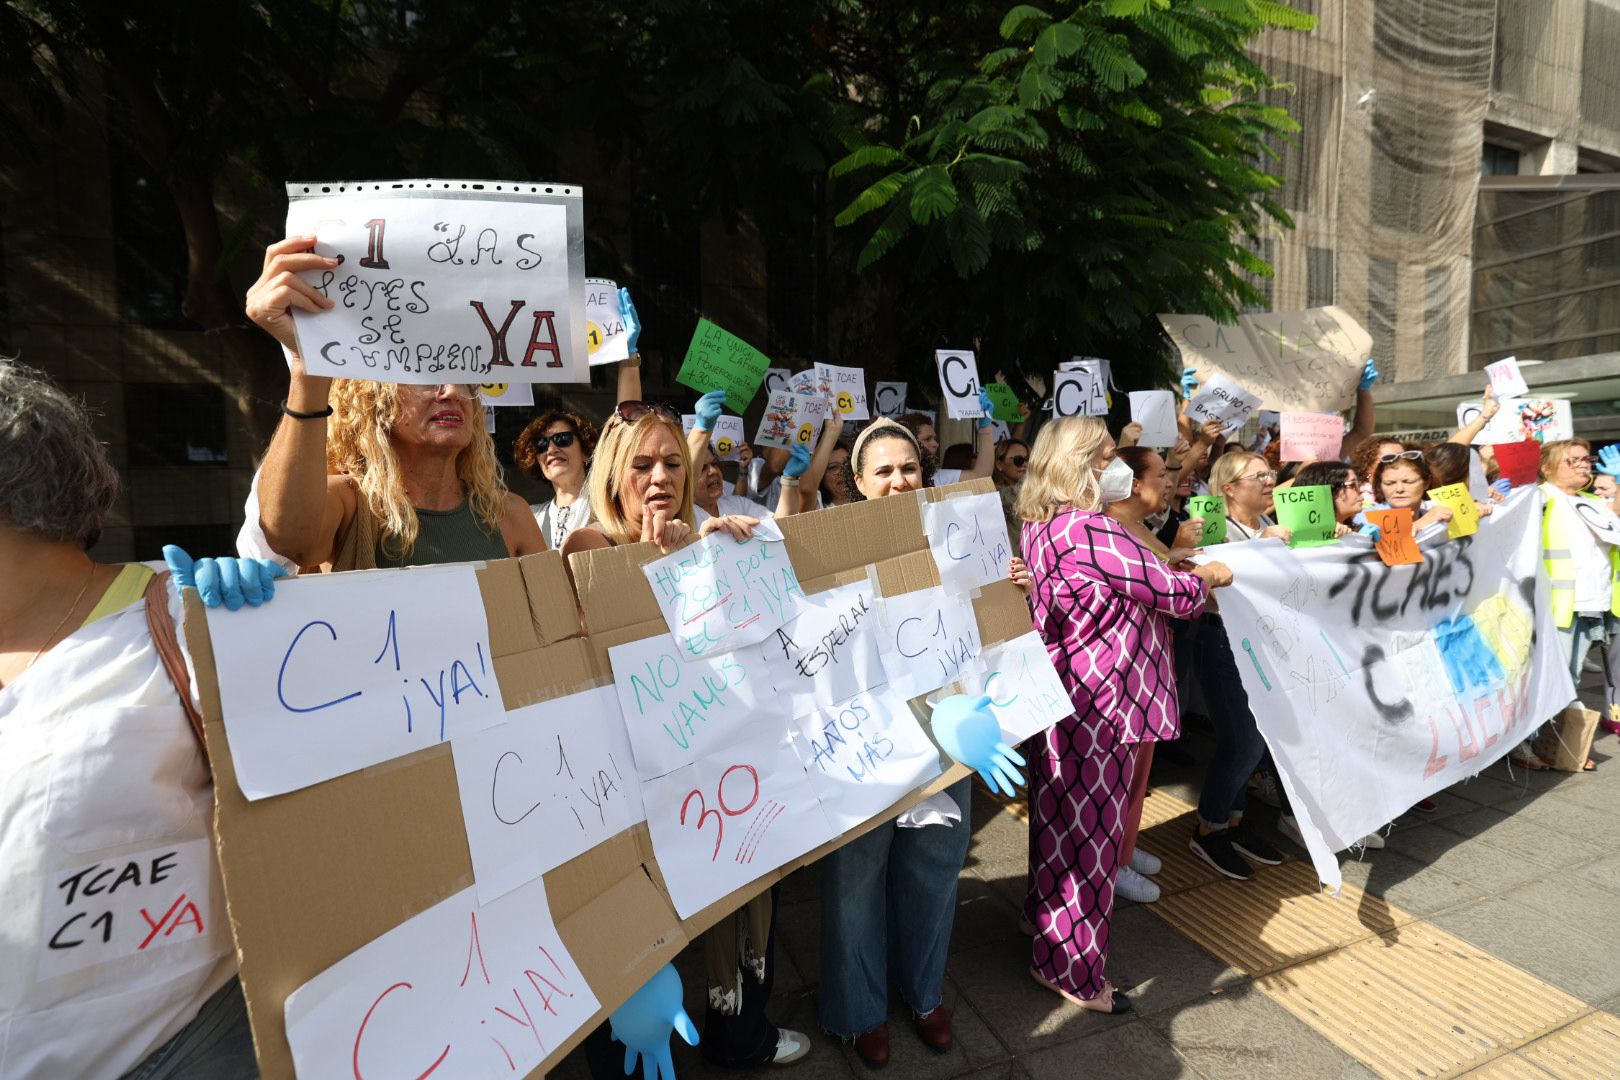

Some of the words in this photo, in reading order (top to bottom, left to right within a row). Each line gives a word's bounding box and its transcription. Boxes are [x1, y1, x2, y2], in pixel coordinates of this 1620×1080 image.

[587, 293, 608, 306] AE
[358, 314, 405, 345] SE
[470, 300, 563, 368] YA
[836, 372, 857, 384] TCAE
[942, 356, 980, 398] C1
[989, 386, 1008, 394] TCAE
[838, 397, 853, 409] C1
[1056, 379, 1088, 417] C1
[1212, 387, 1244, 408] GRUPO
[718, 442, 732, 452] C1
[800, 429, 812, 442] C1
[1278, 491, 1314, 503] TCAE
[1433, 487, 1461, 501] TCAE
[1309, 510, 1321, 524] C1
[1383, 514, 1400, 534] C1
[736, 543, 777, 590] POR
[729, 595, 754, 624] C1
[776, 628, 799, 660] A
[795, 593, 871, 678] ESPERAR
[630, 653, 680, 715] NO
[663, 657, 747, 750] VAMOS
[811, 698, 871, 771] AÑOS
[680, 764, 760, 862] 30
[58, 851, 179, 906] TCAE
[48, 910, 113, 950] C1
[137, 893, 204, 950] YA
